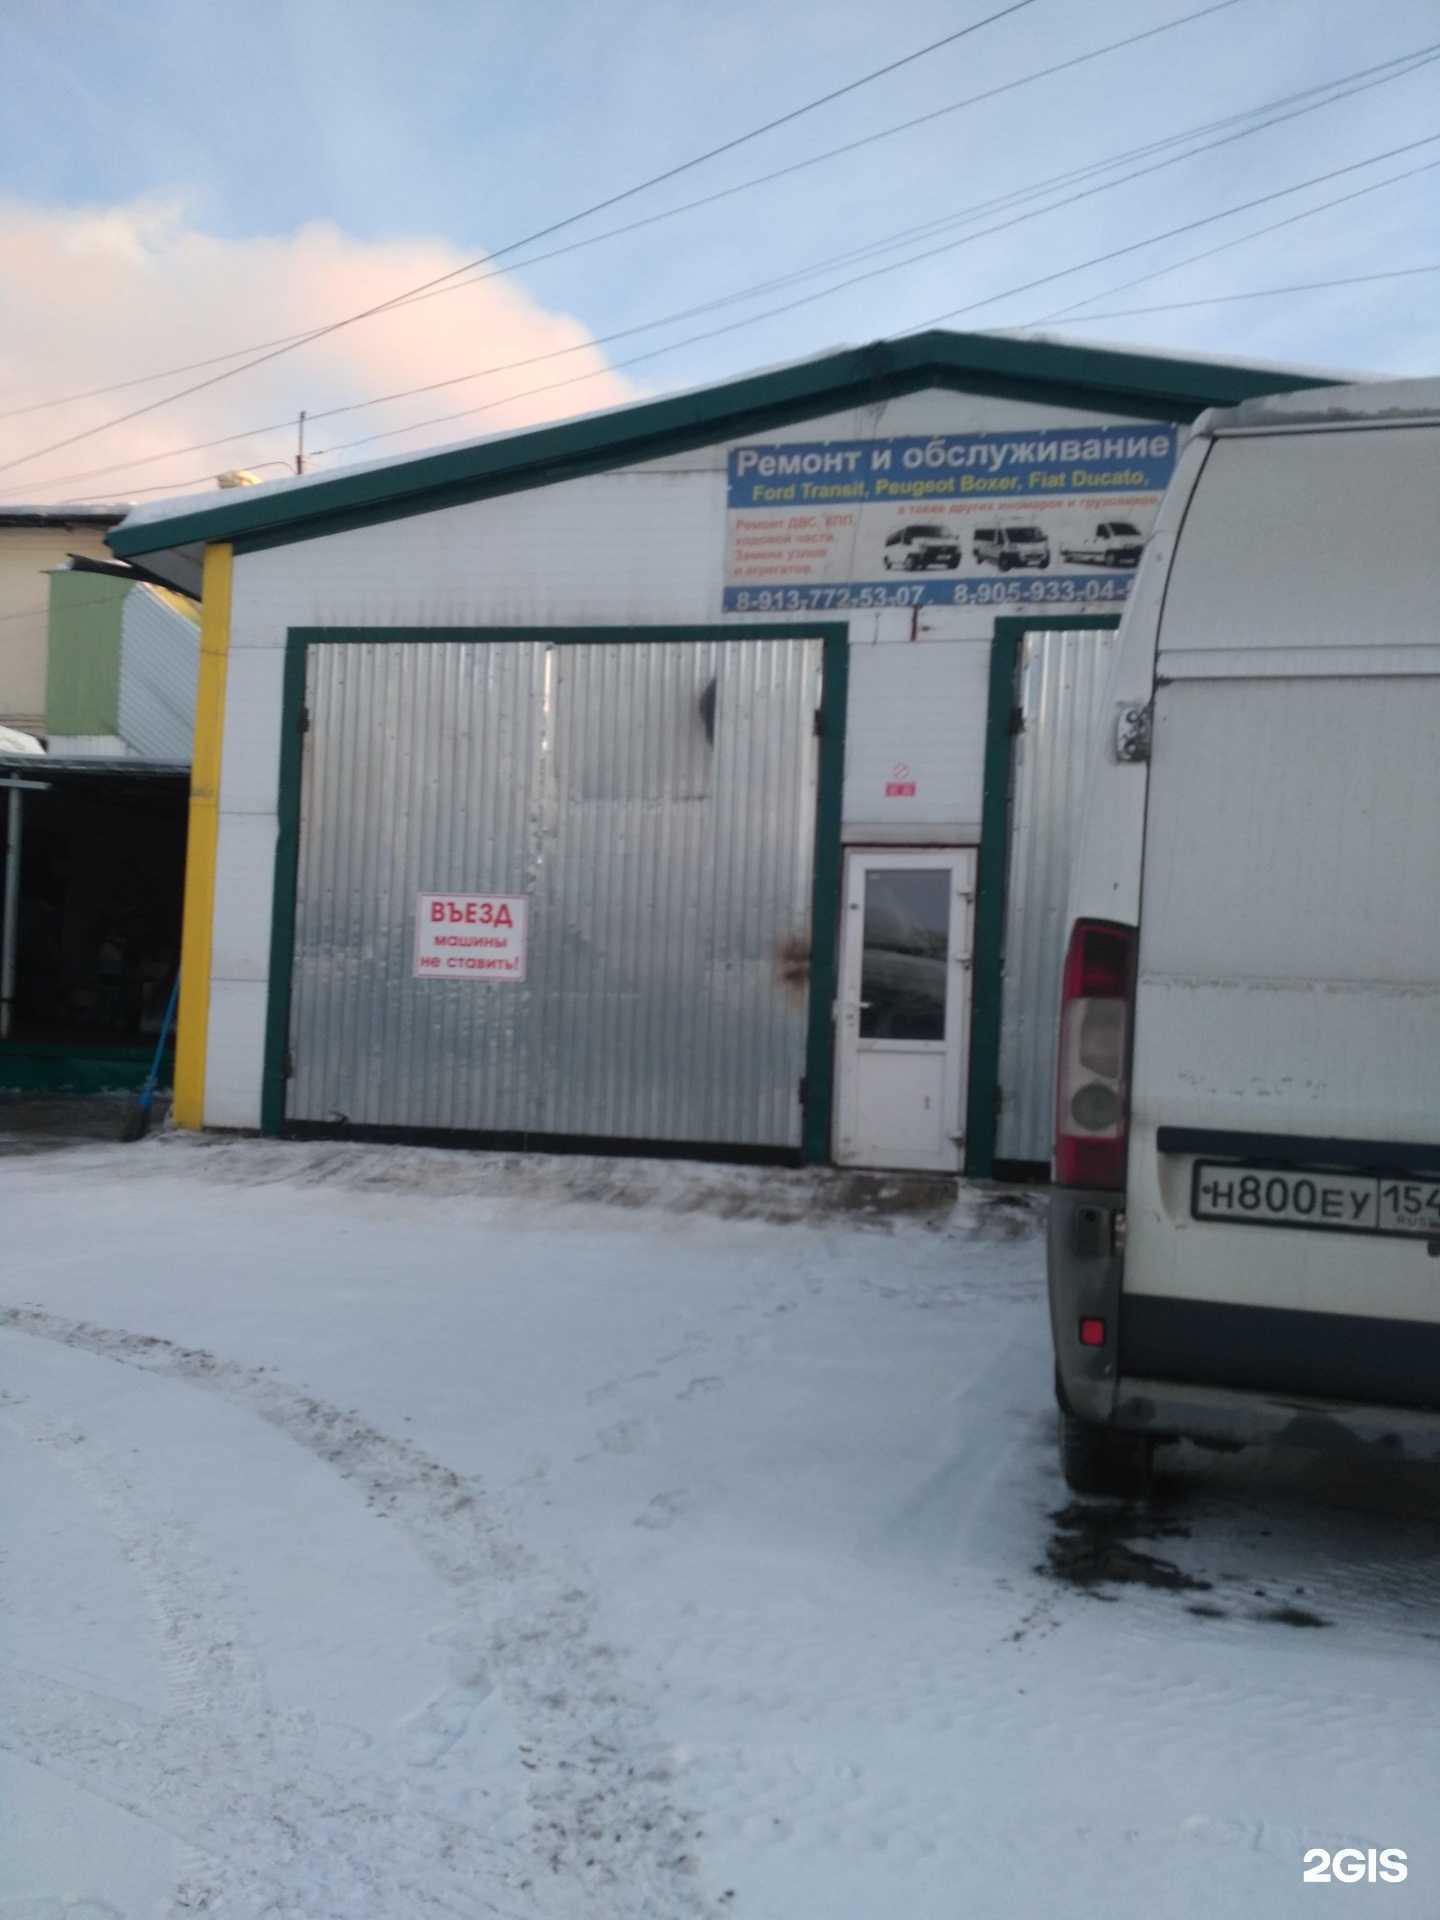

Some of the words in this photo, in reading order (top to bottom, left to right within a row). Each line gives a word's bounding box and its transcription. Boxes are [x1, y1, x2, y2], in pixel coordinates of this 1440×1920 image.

[736, 448, 862, 477] Ремонт
[871, 449, 893, 470] и
[903, 434, 1170, 472] обслуживание
[752, 484, 796, 501] Ford
[802, 481, 870, 499] Transit,
[875, 475, 955, 497] Peugeot
[960, 474, 1023, 492] Boxer,
[1029, 471, 1066, 488] Fiat
[431, 901, 513, 929] ВЪЕЗД
[434, 936, 507, 948] машины
[421, 957, 441, 968] не
[447, 957, 519, 970] ставить!
